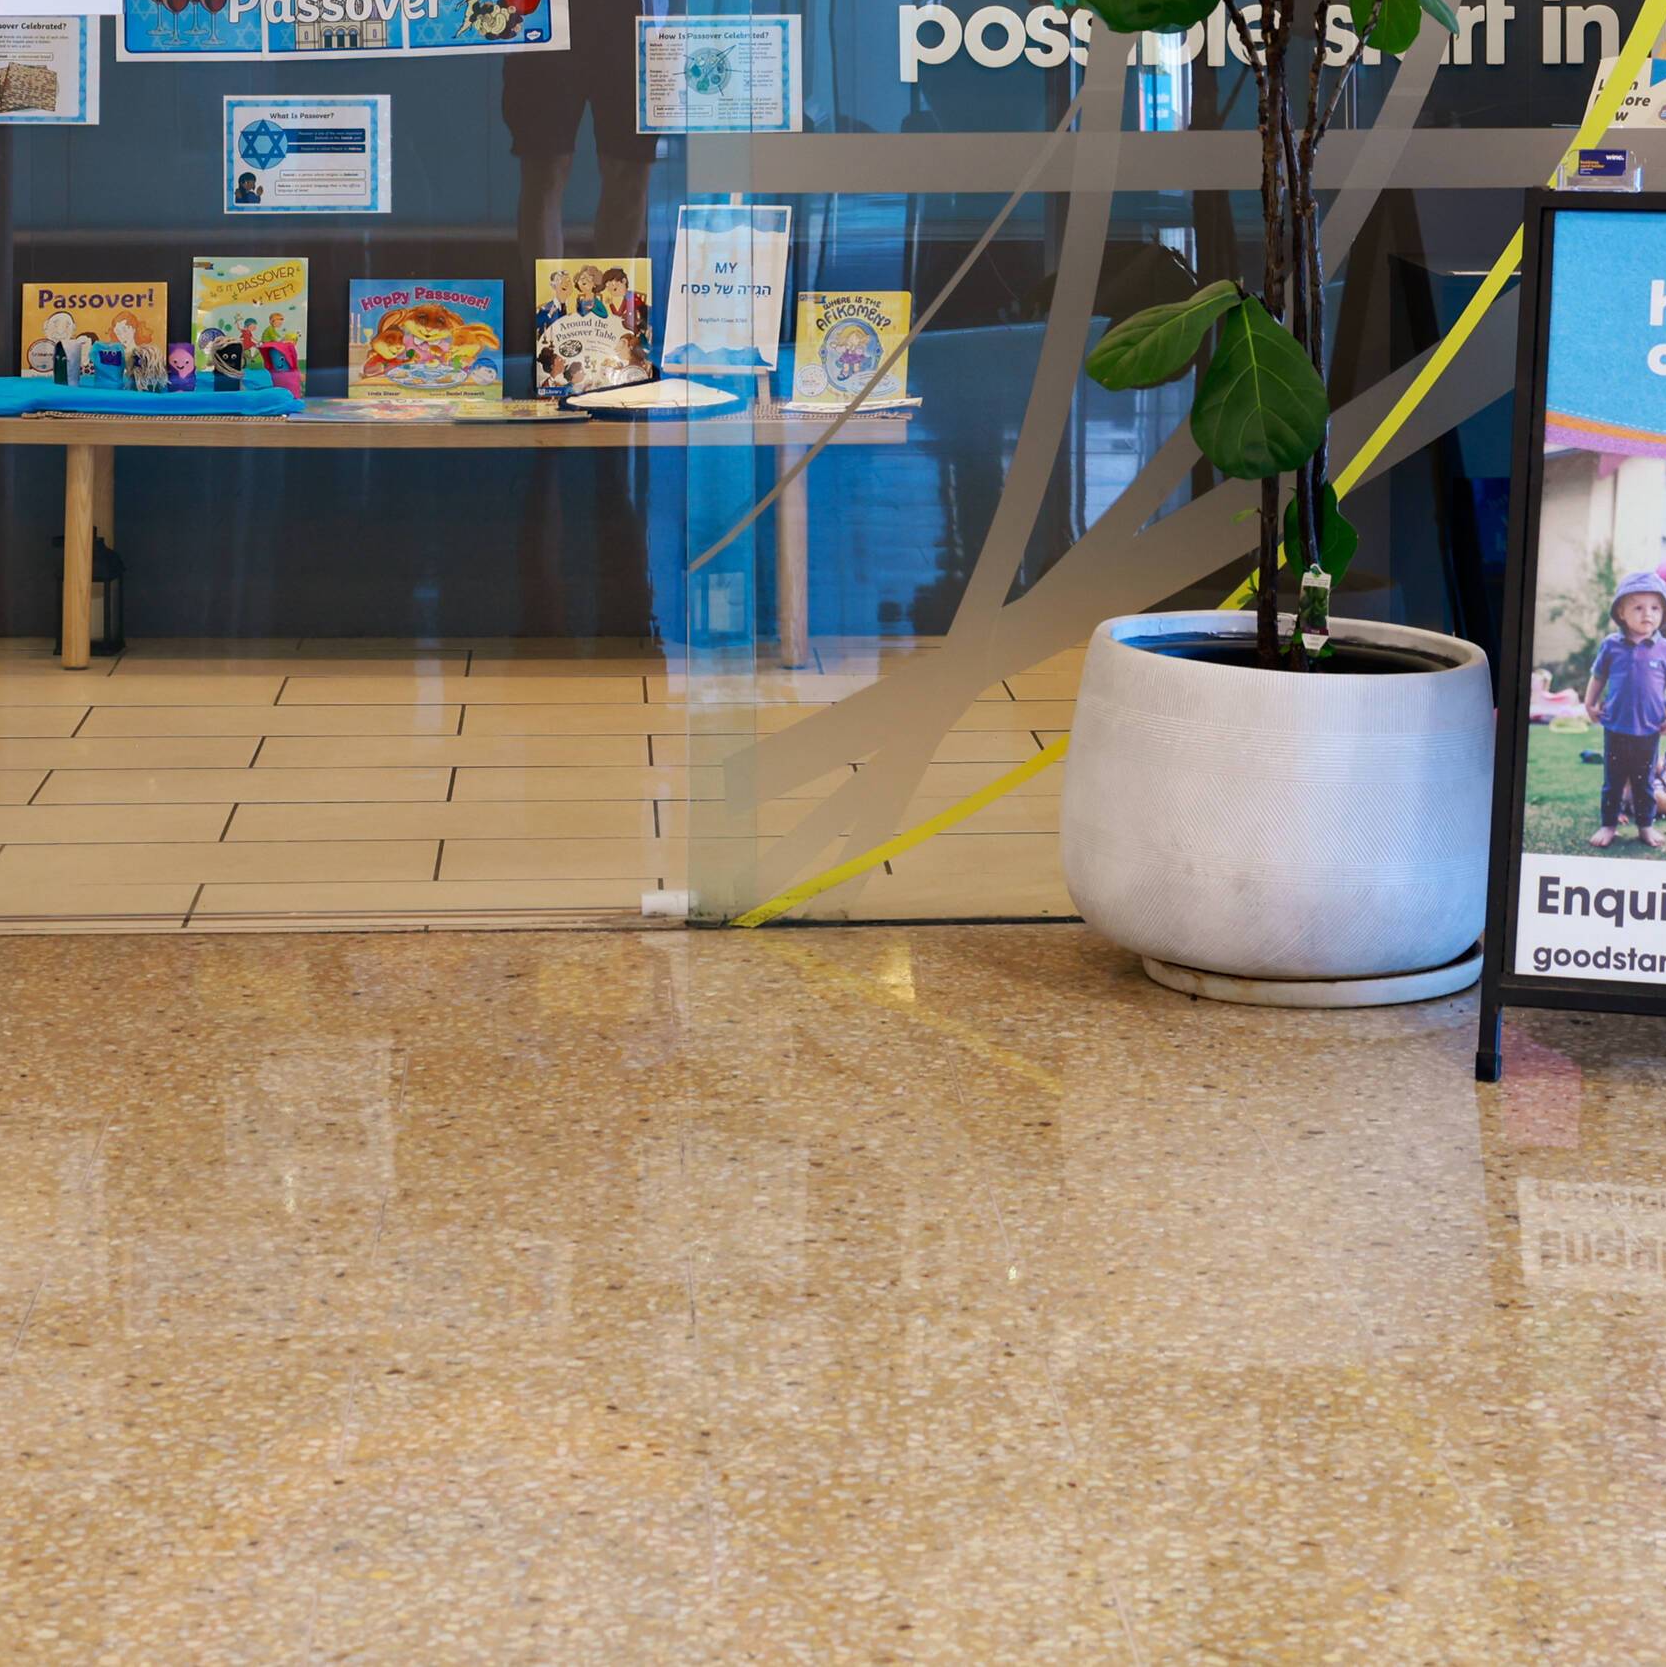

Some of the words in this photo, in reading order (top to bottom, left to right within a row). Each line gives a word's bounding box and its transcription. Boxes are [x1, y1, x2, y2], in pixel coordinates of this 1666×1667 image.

[21, 22, 67, 31] Celebrated?
[658, 32, 675, 40] How
[687, 32, 722, 40] Passover
[715, 262, 738, 274] MY
[226, 284, 234, 292] IT
[236, 266, 296, 293] PASSOVER
[39, 288, 154, 309] Passover!
[265, 283, 295, 302] YET?
[414, 287, 491, 311] Passover!
[823, 296, 851, 311] WHERE
[854, 296, 863, 304] IS
[865, 297, 882, 308] THE
[560, 318, 592, 332] Around
[595, 319, 609, 329] the
[555, 329, 593, 343] Passover
[595, 328, 617, 343] Table
